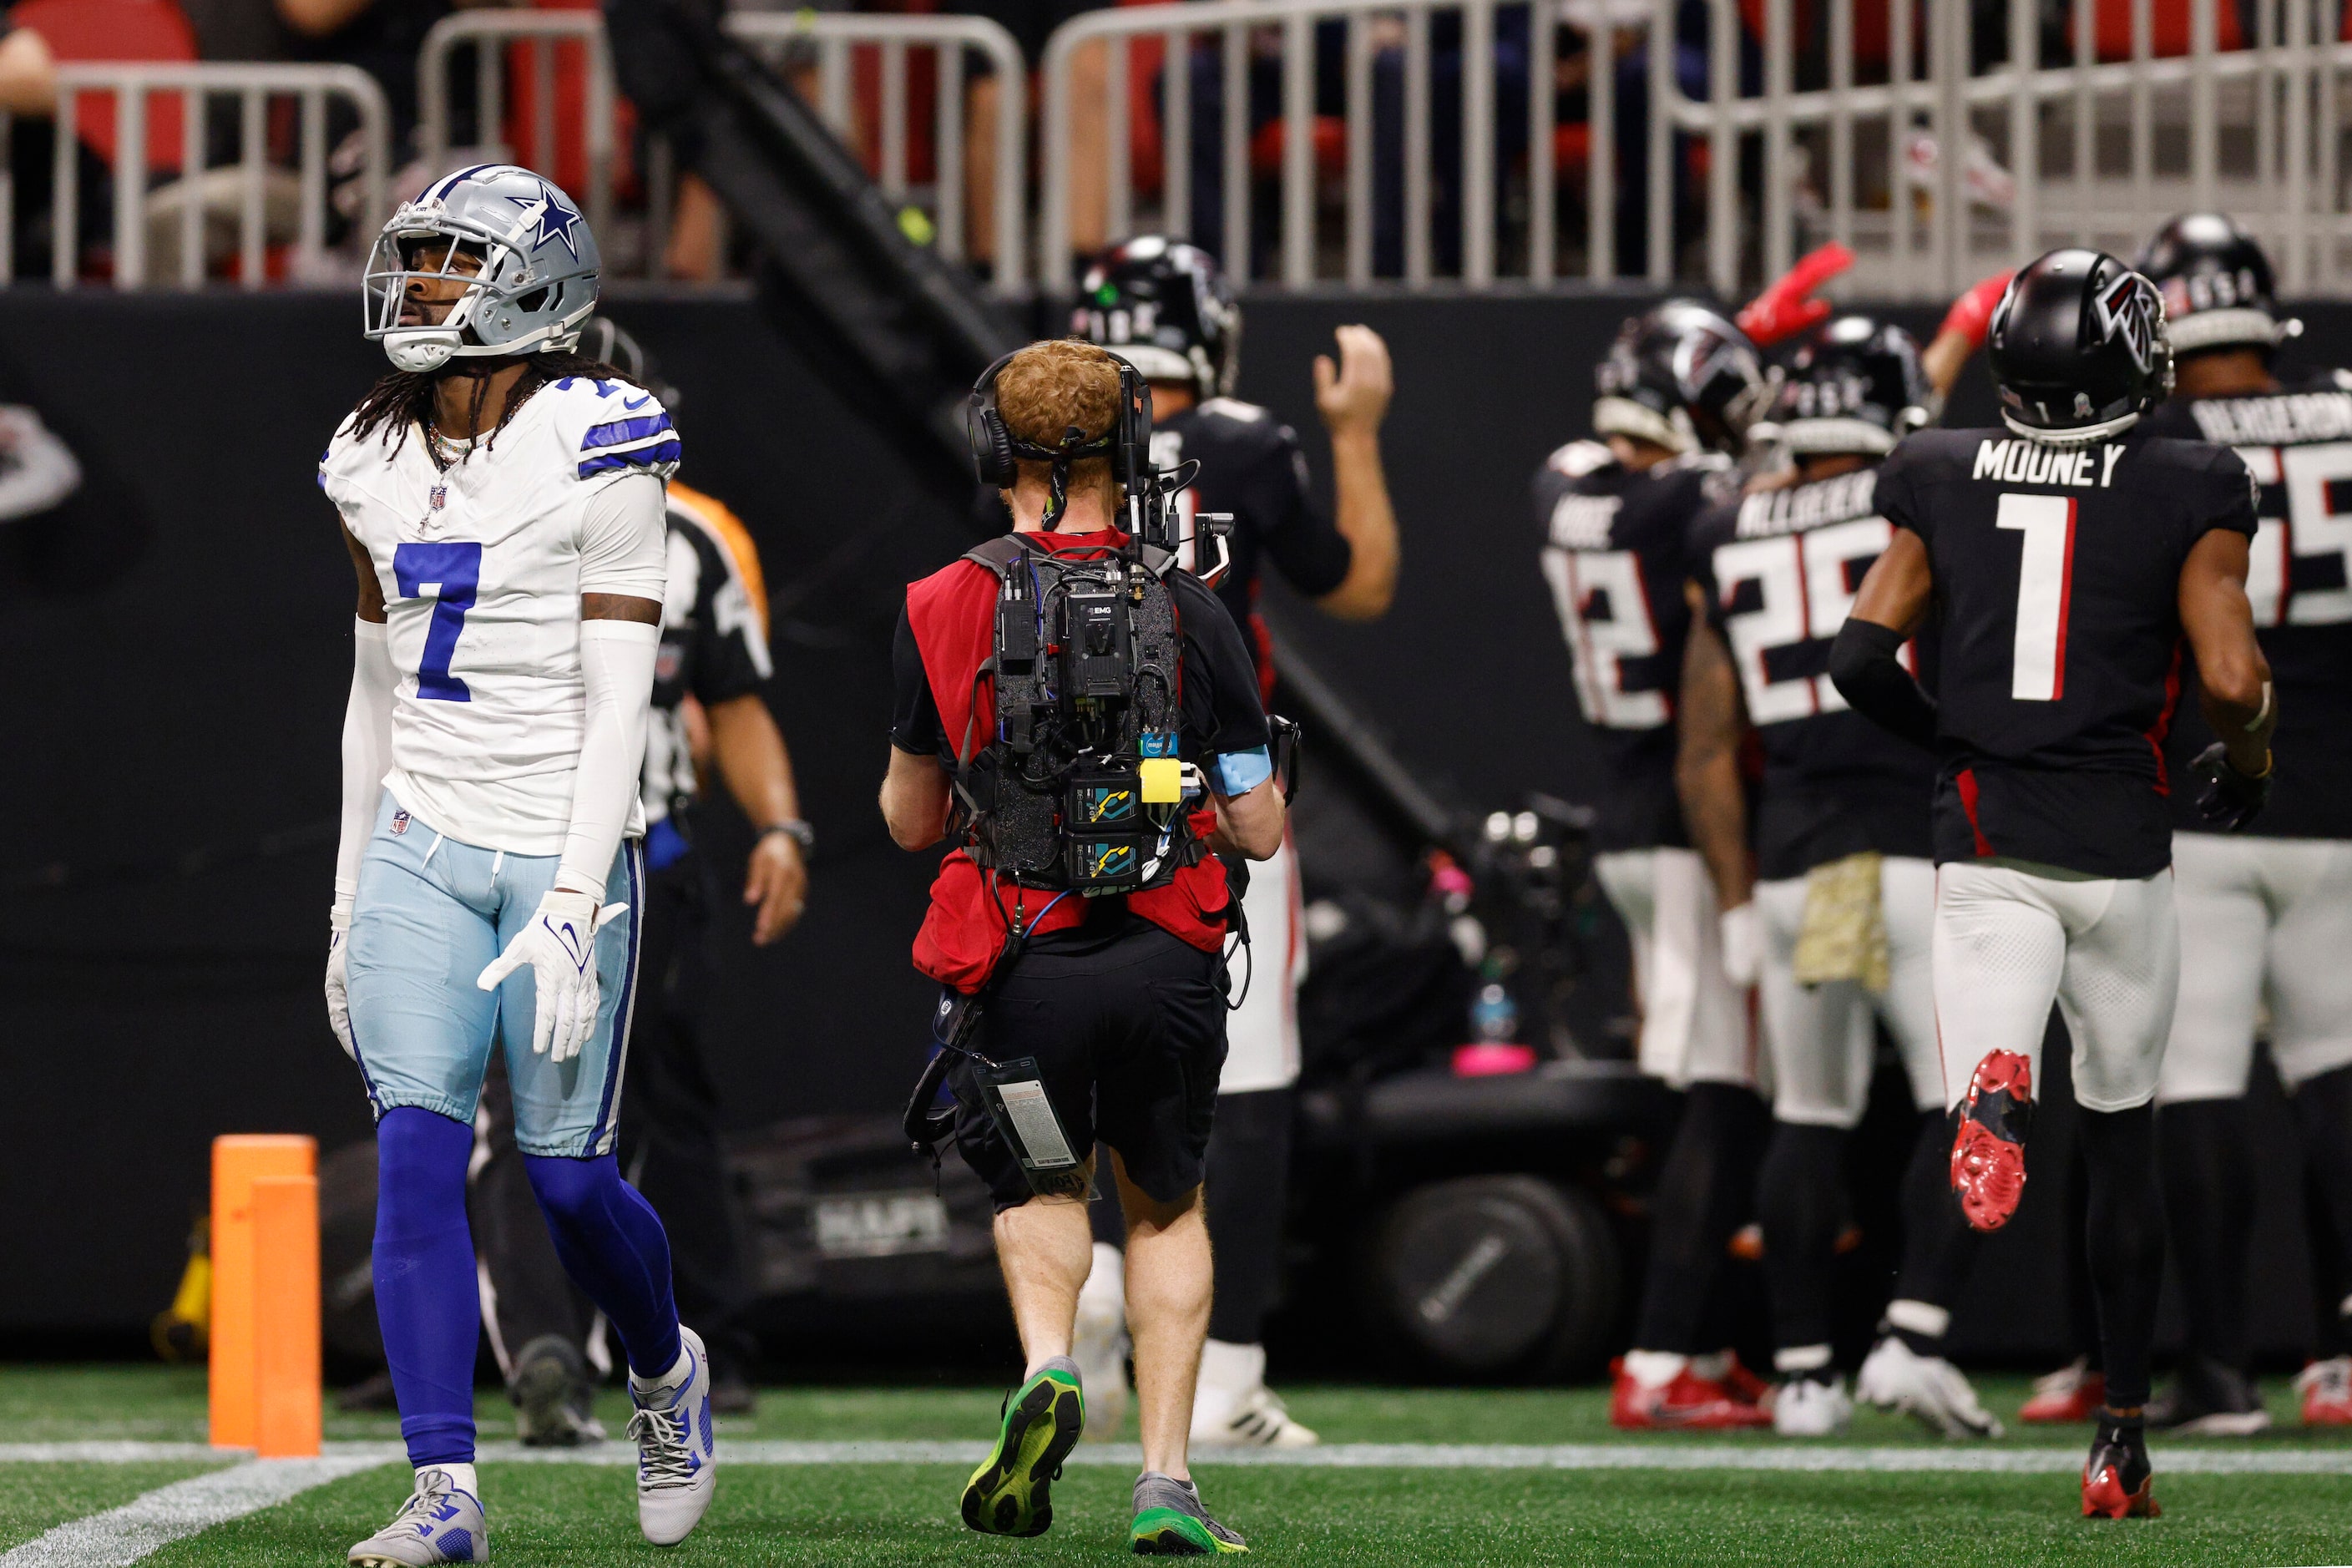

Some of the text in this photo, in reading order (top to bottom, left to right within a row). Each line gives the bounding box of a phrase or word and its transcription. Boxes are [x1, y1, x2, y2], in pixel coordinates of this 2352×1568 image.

[1971, 438, 2127, 488] MOONEY
[393, 542, 482, 702] 7
[1540, 546, 1675, 730] 12
[1995, 493, 2077, 701] 1
